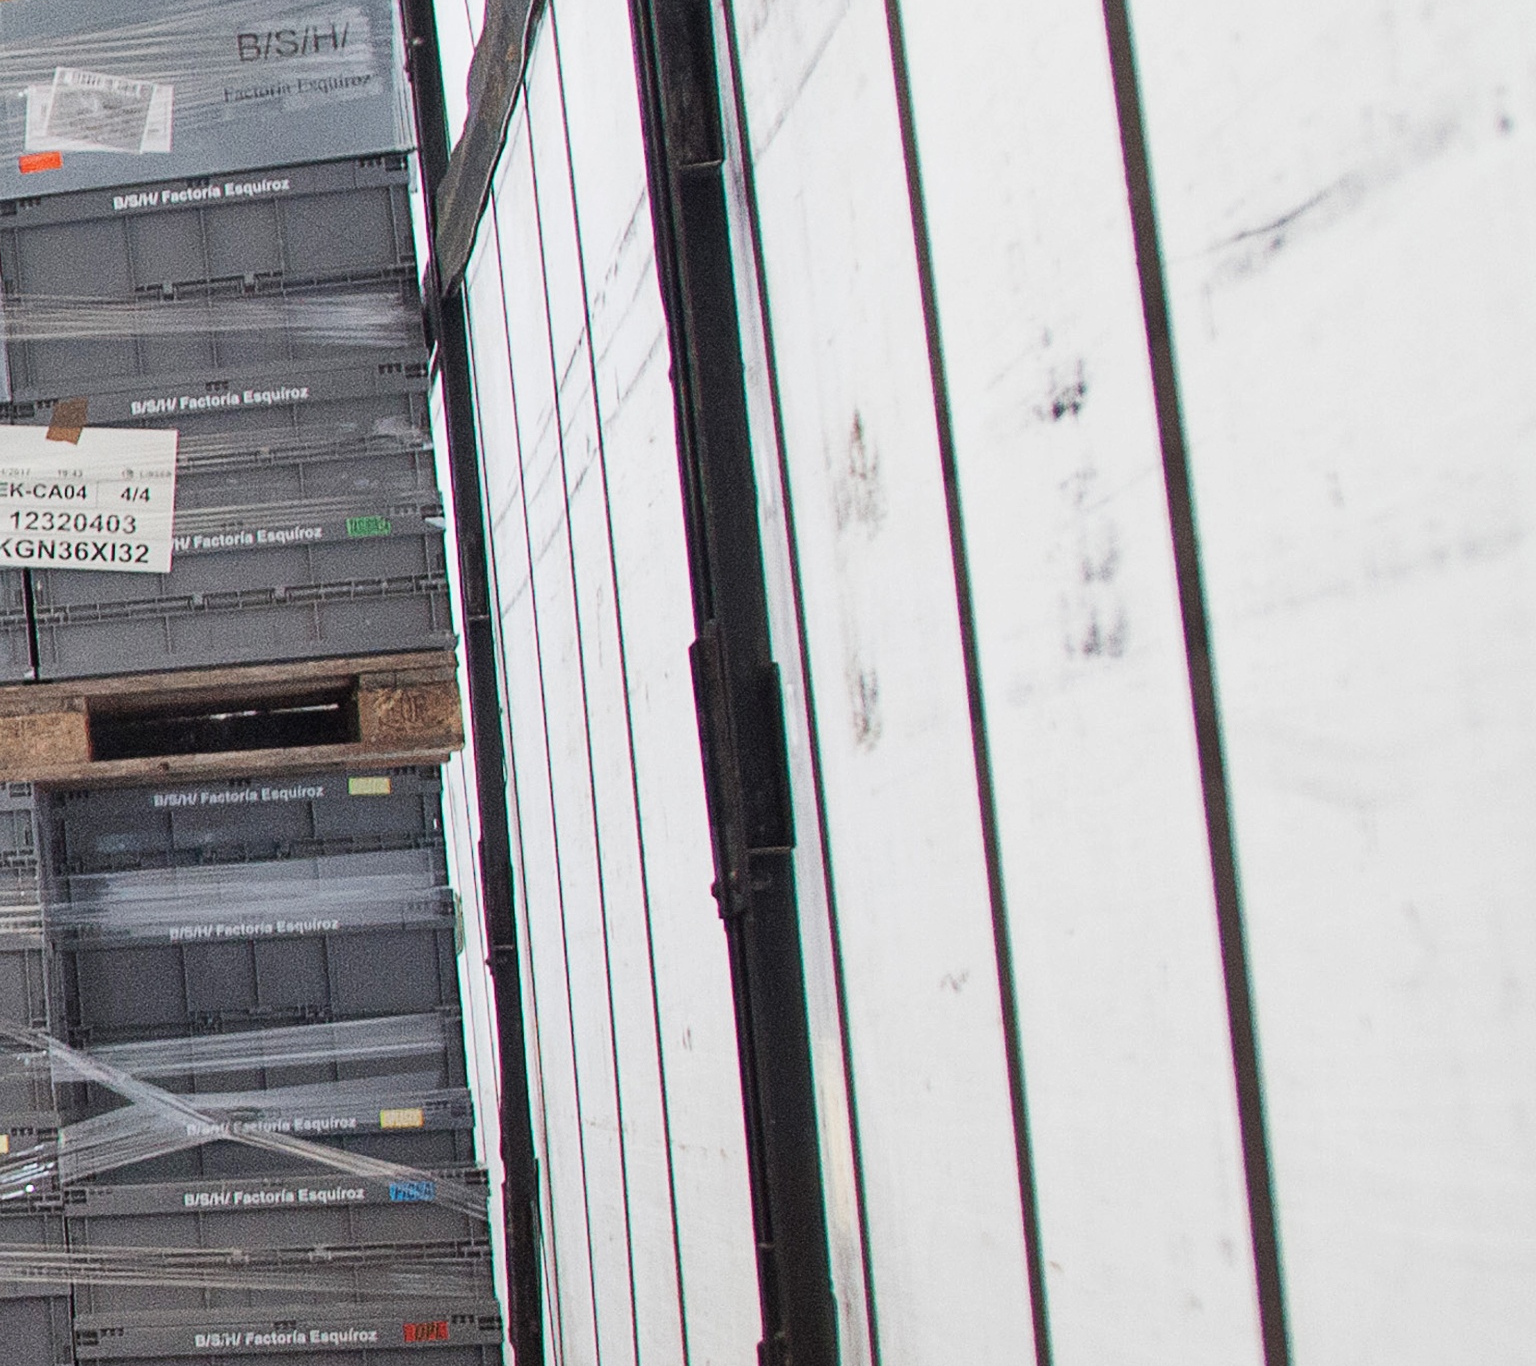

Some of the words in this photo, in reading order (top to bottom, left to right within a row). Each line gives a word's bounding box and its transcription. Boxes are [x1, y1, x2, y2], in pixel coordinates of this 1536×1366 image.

[237, 21, 349, 62] B/S/H/
[120, 486, 151, 502] 4/4
[10, 511, 137, 534] 12320403
